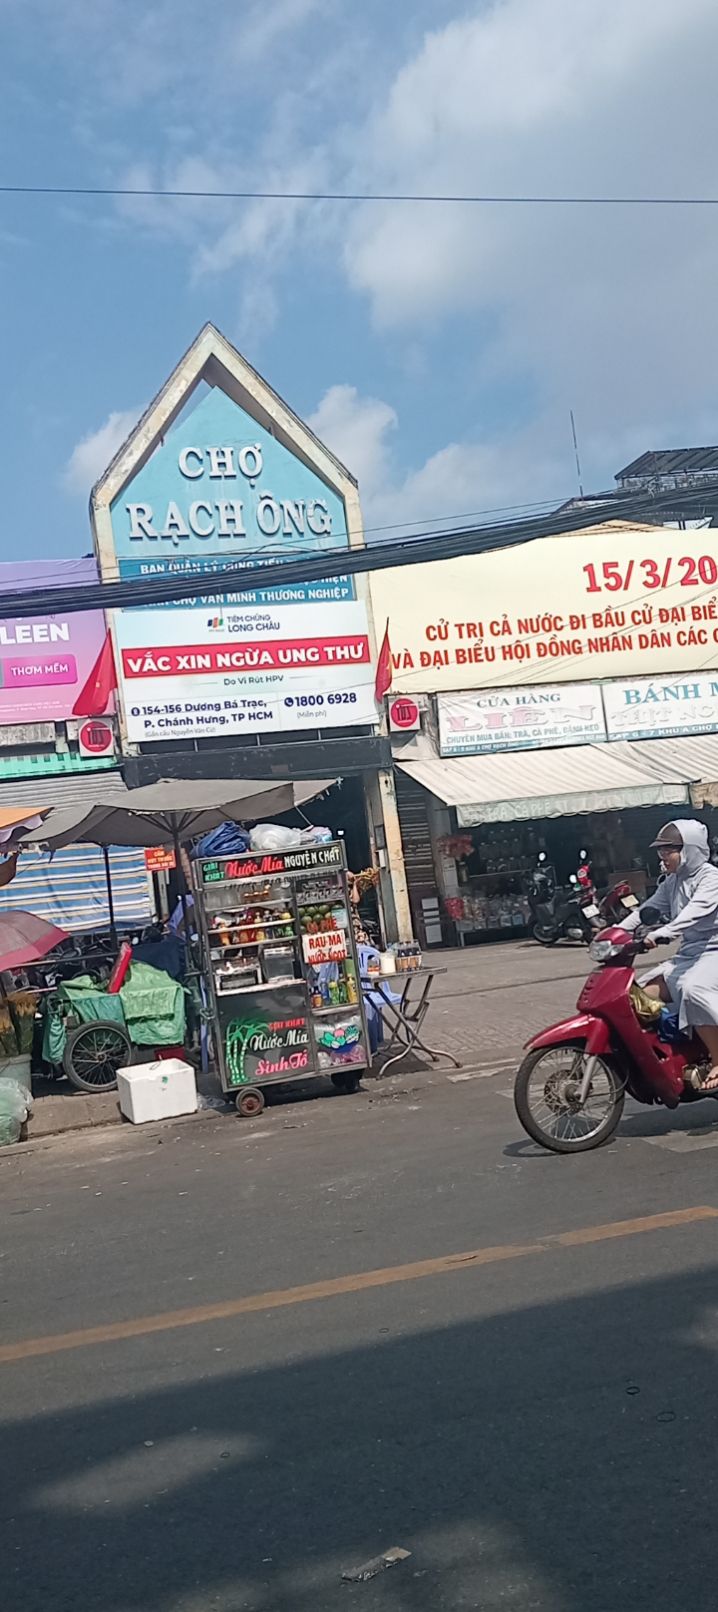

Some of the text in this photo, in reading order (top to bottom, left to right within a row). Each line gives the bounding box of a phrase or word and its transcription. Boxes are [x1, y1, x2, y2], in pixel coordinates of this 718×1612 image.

[179, 443, 263, 487] CHỢ
[126, 491, 332, 545] RẠCH ÔNG
[141, 563, 165, 575] BAN
[226, 592, 257, 603] MINH
[259, 588, 305, 602] THƯƠNG
[308, 586, 349, 600] NGHIỆP
[228, 623, 254, 633] LONG
[255, 620, 281, 632] CHÂU
[425, 618, 449, 642] CỬ
[454, 622, 484, 640] TRI
[489, 613, 512, 637] CẢ
[517, 611, 564, 635] NƯỚC
[569, 613, 587, 631] ĐI
[592, 605, 626, 629] BẦU
[631, 602, 653, 626] CỬ
[659, 606, 687, 628] ĐẠI
[391, 651, 415, 670] VÀ
[420, 649, 450, 670] ĐẠI
[455, 638, 496, 666] BIỂU
[501, 642, 531, 665] HỘI
[537, 633, 584, 658] ĐỒNG
[588, 631, 635, 655] NHÂN
[638, 628, 671, 650] DÂN
[676, 624, 709, 647] CÁC
[127, 642, 365, 674] VẮC XIN NGỪA UNG THƯ
[11, 665, 43, 677] THƠM
[223, 677, 237, 686] Do
[238, 676, 247, 685] Vi
[265, 675, 284, 683] HPV
[294, 692, 357, 707] 1800 6928
[476, 692, 560, 708] CỬA HÀNG
[623, 682, 702, 705] BÁNH
[142, 703, 182, 716] 154-156
[224, 699, 239, 710] Bá
[240, 698, 268, 710] Trạc,
[144, 710, 273, 729] P. Chánh Hưng, TP HCM
[658, 728, 680, 736] KHU
[682, 725, 690, 733] A
[691, 724, 713, 732] CHỢ
[224, 859, 261, 878] Nước
[308, 935, 327, 950] RAU
[250, 1028, 310, 1052] Nước Mía
[255, 1049, 308, 1076] Sinh Tố
